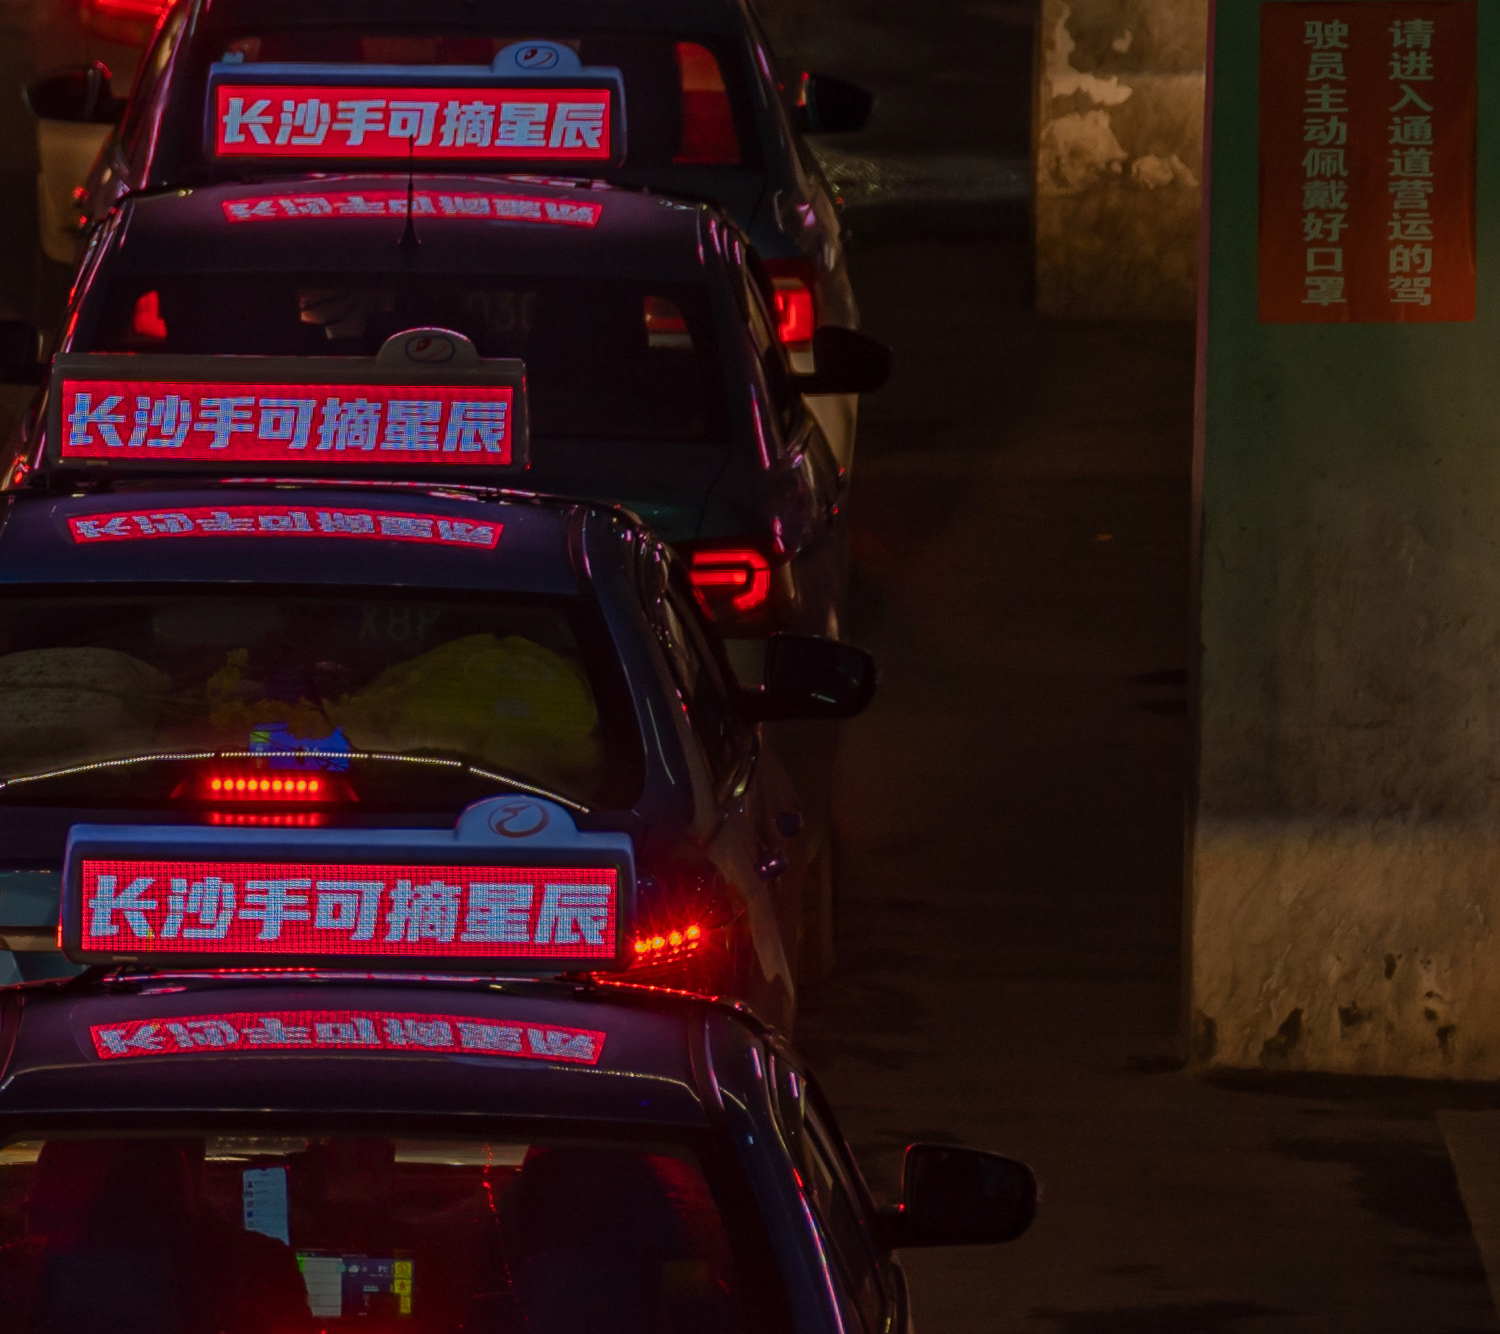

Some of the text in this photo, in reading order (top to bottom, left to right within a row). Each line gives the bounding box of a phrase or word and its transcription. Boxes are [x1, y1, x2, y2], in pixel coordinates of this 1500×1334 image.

[223, 98, 604, 148] 长沙手可摘星辰
[1301, 18, 1349, 307] 驶员主动佩戴好口罩
[1387, 18, 1435, 307] 请进入通道营运的驾
[68, 393, 506, 452] 长沙手可摘星辰
[89, 875, 610, 944] 长沙手可摘星辰
